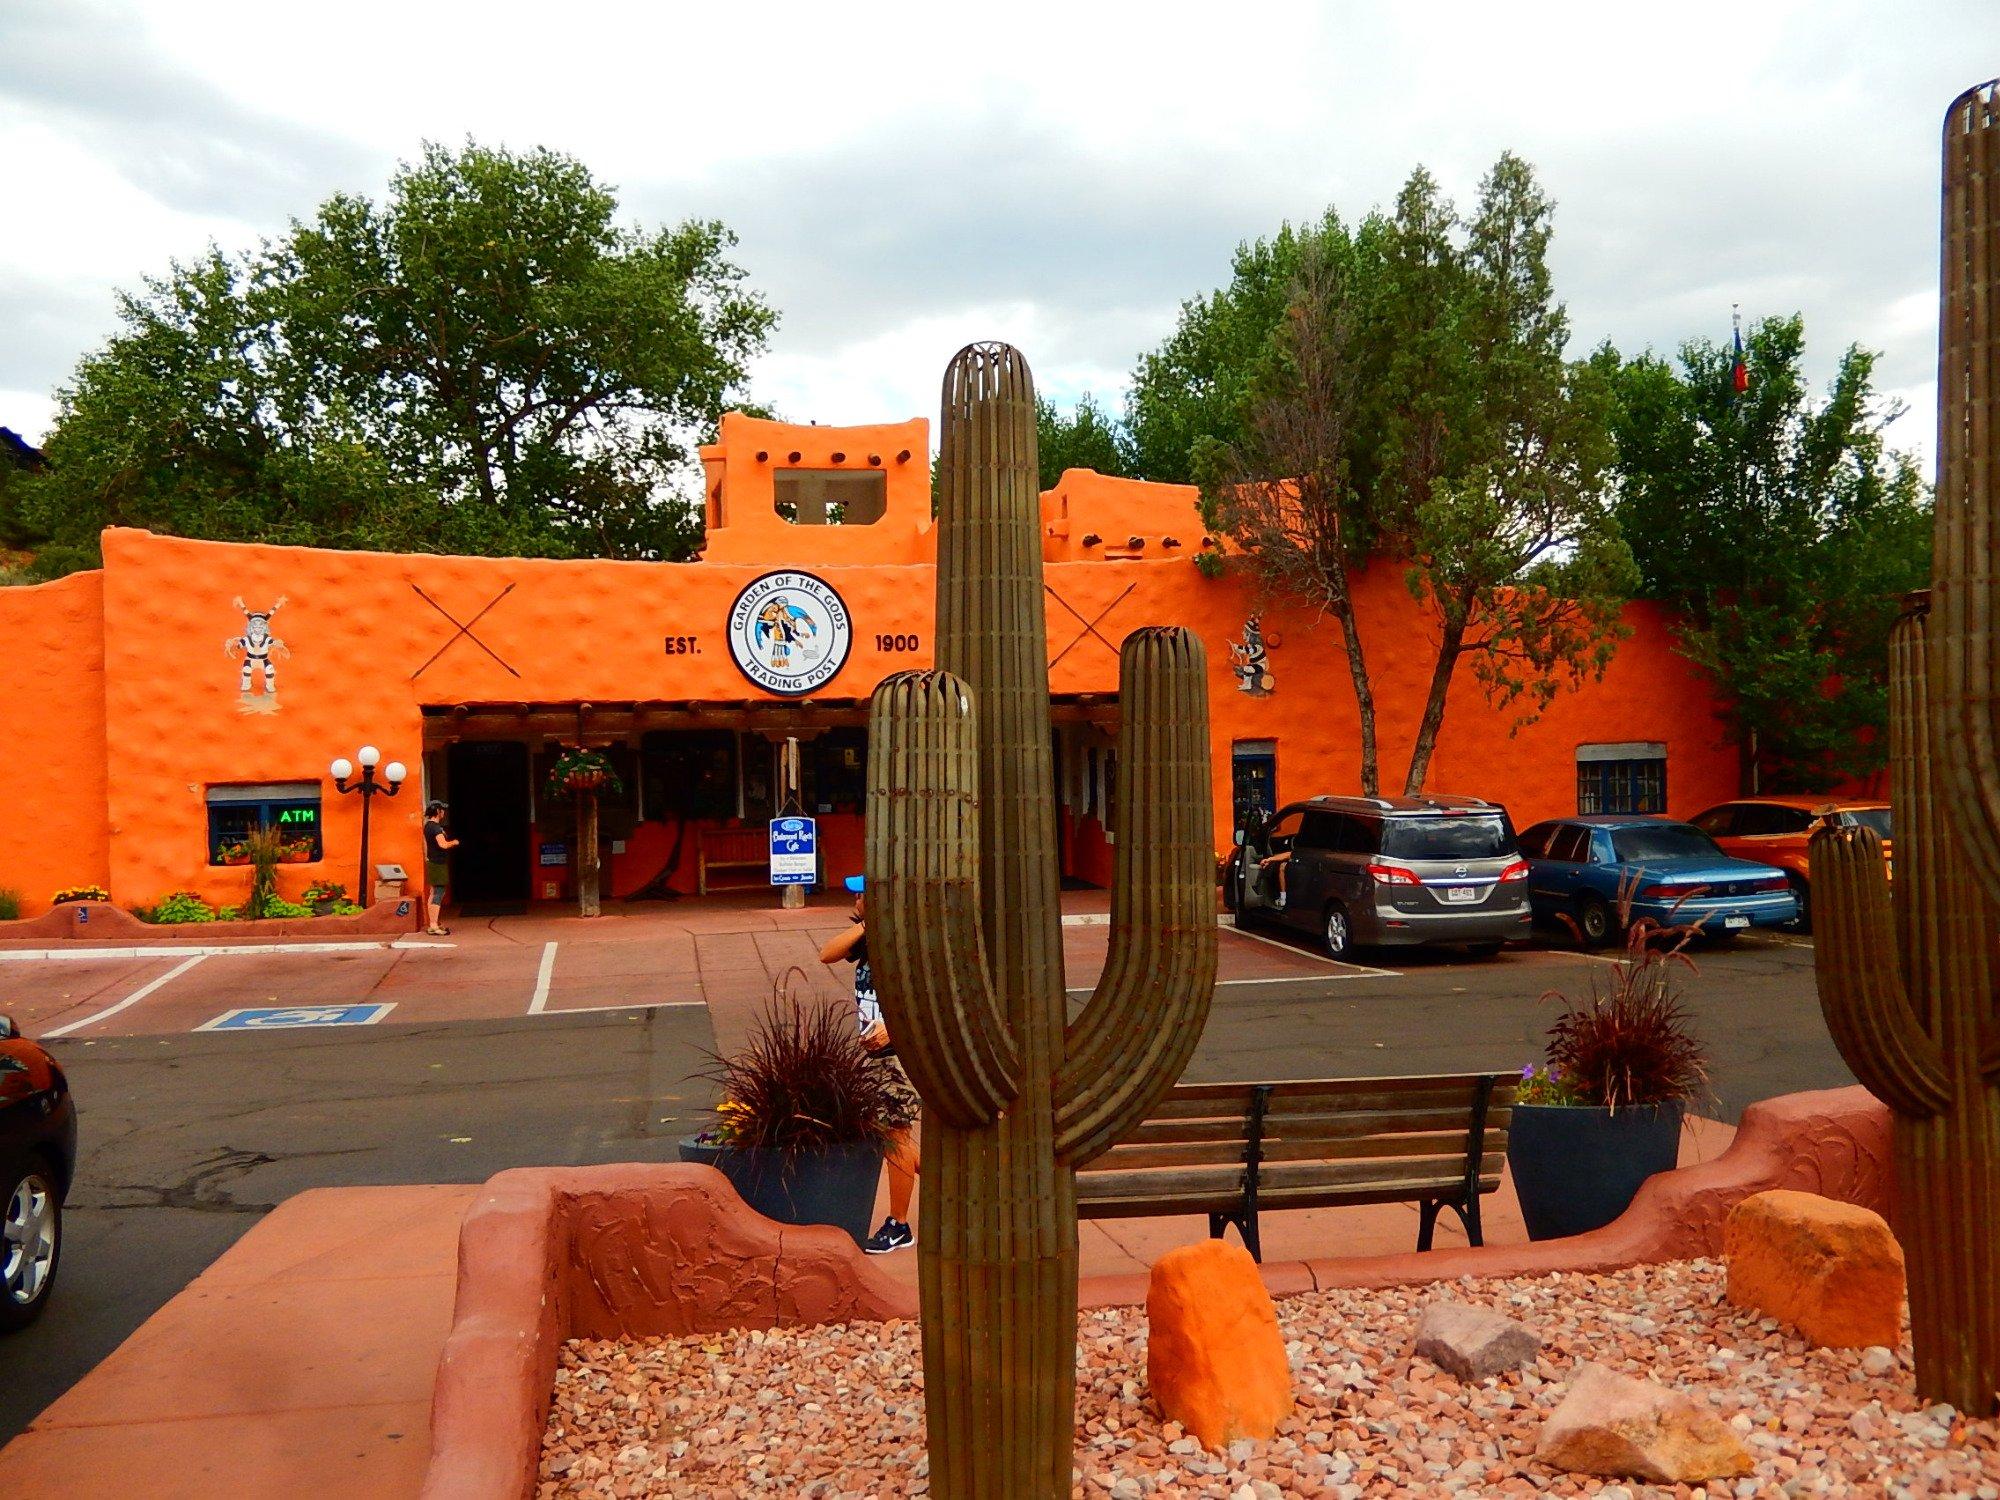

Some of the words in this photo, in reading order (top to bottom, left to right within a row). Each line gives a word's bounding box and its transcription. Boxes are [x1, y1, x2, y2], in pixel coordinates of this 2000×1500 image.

[733, 581, 771, 631] GARDEN
[774, 575, 793, 587] OF
[798, 576, 823, 596] THE
[823, 594, 846, 631] GODS
[664, 636, 702, 655] EST.
[875, 634, 920, 652] 1900
[744, 658, 803, 690] TRADING
[807, 658, 837, 685] POST
[280, 810, 314, 822] ATM
